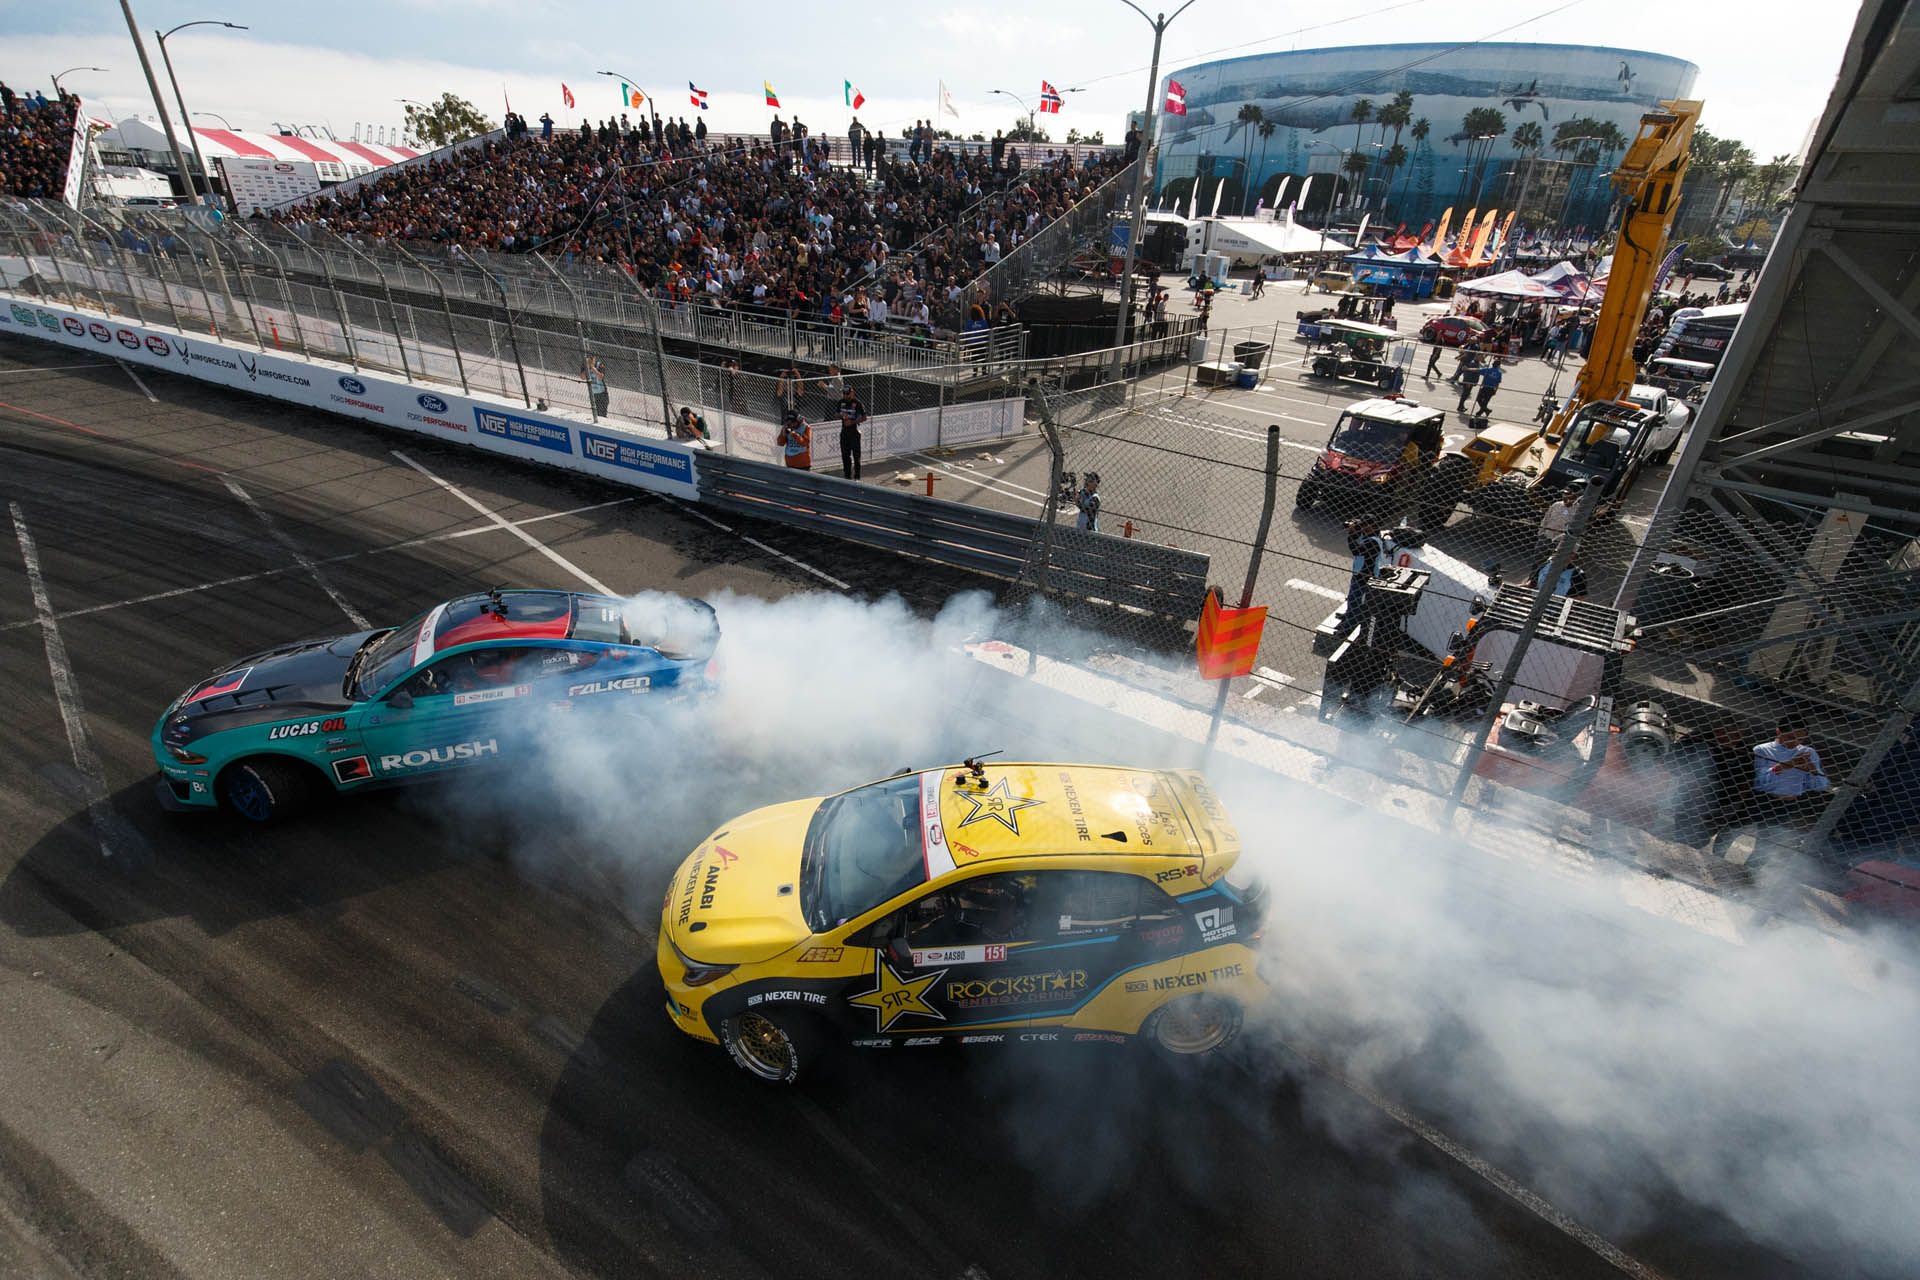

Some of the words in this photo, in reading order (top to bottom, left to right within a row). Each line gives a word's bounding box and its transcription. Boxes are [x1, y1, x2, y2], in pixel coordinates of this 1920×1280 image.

[190, 352, 238, 370] AIRFORCE.COM
[258, 368, 311, 387] AIRFORCE.COM
[343, 378, 361, 393] Ford
[345, 398, 385, 413] PERFORMANCE
[423, 396, 444, 412] Ford
[422, 416, 468, 432] PERFORMANCE
[480, 413, 507, 434] NOS
[509, 421, 523, 431] HIGH
[523, 423, 567, 442] PERFORMANCE
[586, 437, 618, 460] NOS
[620, 446, 636, 459] HIGH
[636, 449, 686, 470] PERFORMANCE
[568, 676, 651, 697] FALKEN
[269, 721, 320, 740] LUCAS
[321, 717, 347, 732] OIL
[380, 738, 498, 771] ROUSH
[1064, 784, 1084, 816] NEXEN
[1073, 817, 1091, 842] TIRE
[953, 840, 981, 858] TRD
[684, 860, 704, 896] NEXEN
[700, 865, 721, 910] ANABI
[679, 895, 693, 927] TIRE
[1204, 929, 1238, 943] RACING
[986, 946, 1006, 960] 151
[1153, 971, 1208, 991] NEXEN
[1211, 963, 1245, 982] TIRE
[765, 991, 801, 1002] NEXEN
[802, 991, 828, 1005] TIRE
[1019, 1033, 1059, 1041] CTEK
